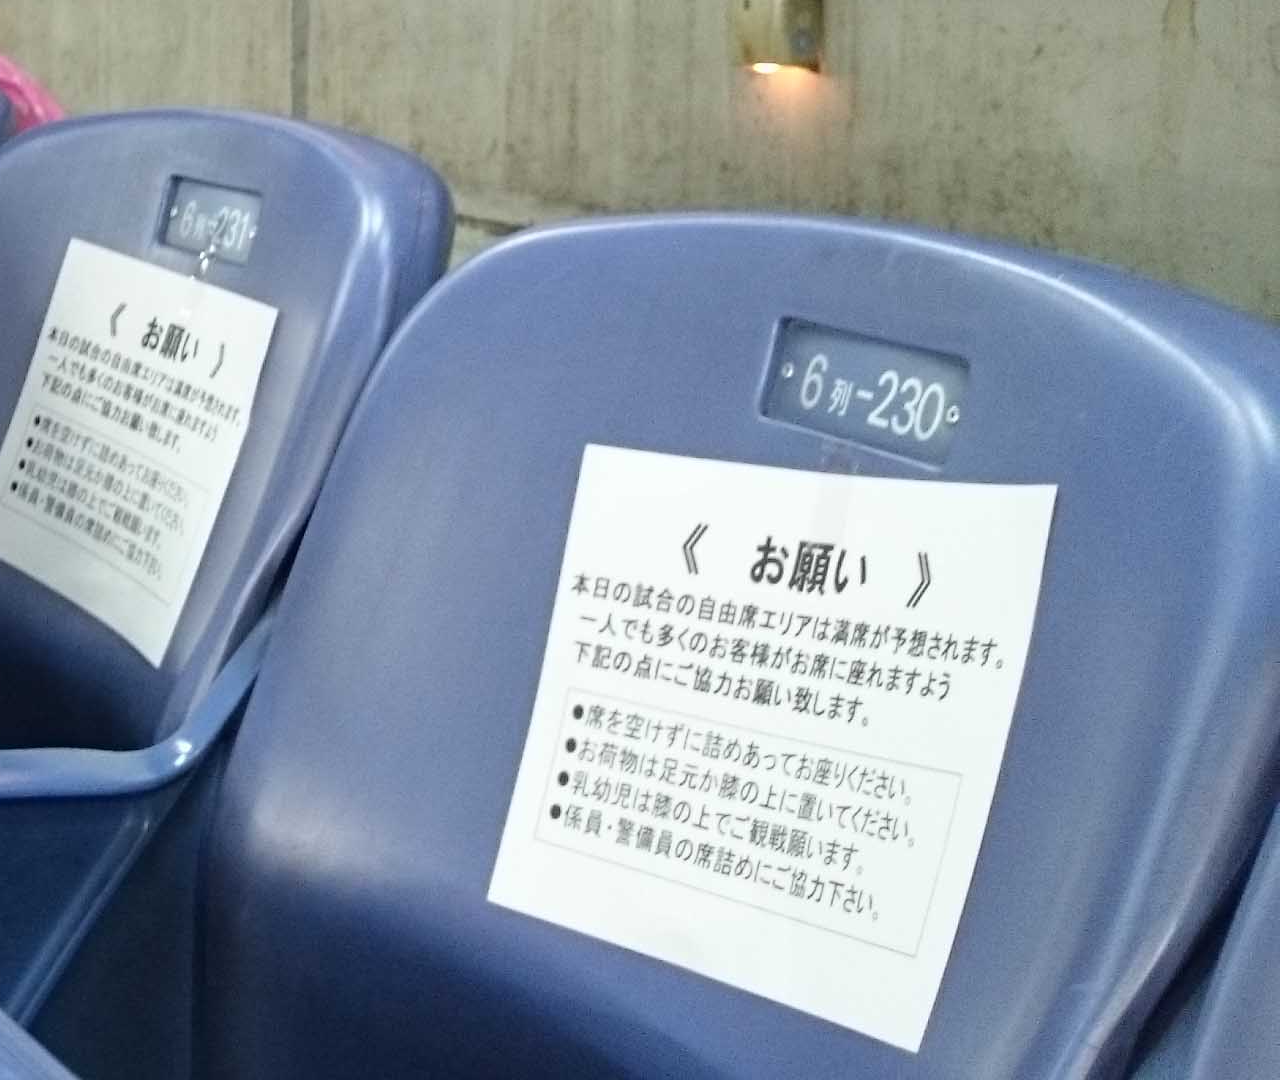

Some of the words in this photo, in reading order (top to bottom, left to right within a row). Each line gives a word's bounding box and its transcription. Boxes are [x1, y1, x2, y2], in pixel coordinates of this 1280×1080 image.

[571, 572, 1004, 670] 本日の試合の自由席エリアは満席が予想されます。
[579, 611, 952, 701] 一人でも多くのお客様がお席に座れますよう
[574, 640, 869, 728] 下記の点にご協力お願い致します。
